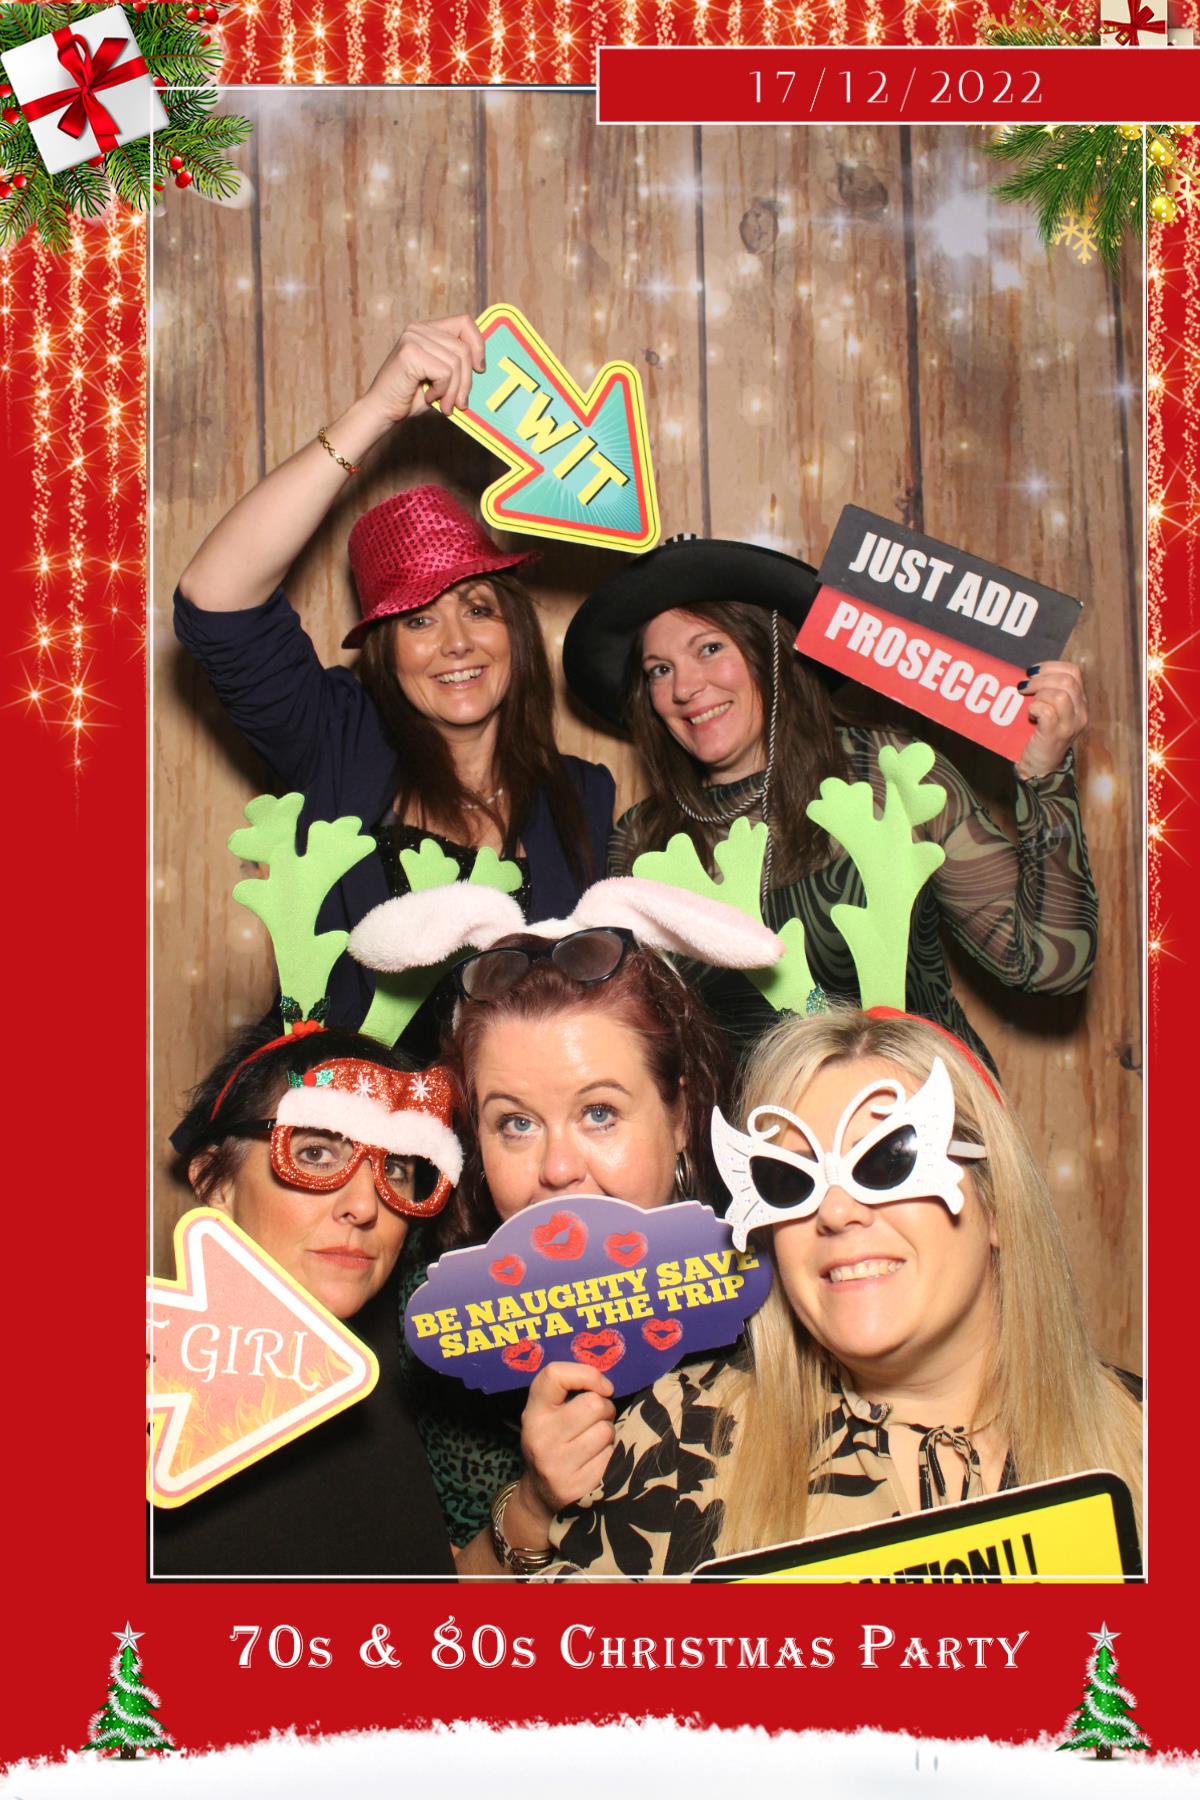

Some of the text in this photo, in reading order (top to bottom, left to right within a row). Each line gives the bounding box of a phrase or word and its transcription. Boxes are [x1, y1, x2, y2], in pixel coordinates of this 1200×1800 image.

[485, 356, 631, 506] TWIT
[848, 531, 1039, 637] JUST ADD
[824, 600, 1025, 727] PROSECCO
[411, 1245, 760, 1338] BE NAUGHTY SAVE
[439, 1274, 746, 1358] SANTA THE TRIP
[180, 1323, 322, 1391] GIRL
